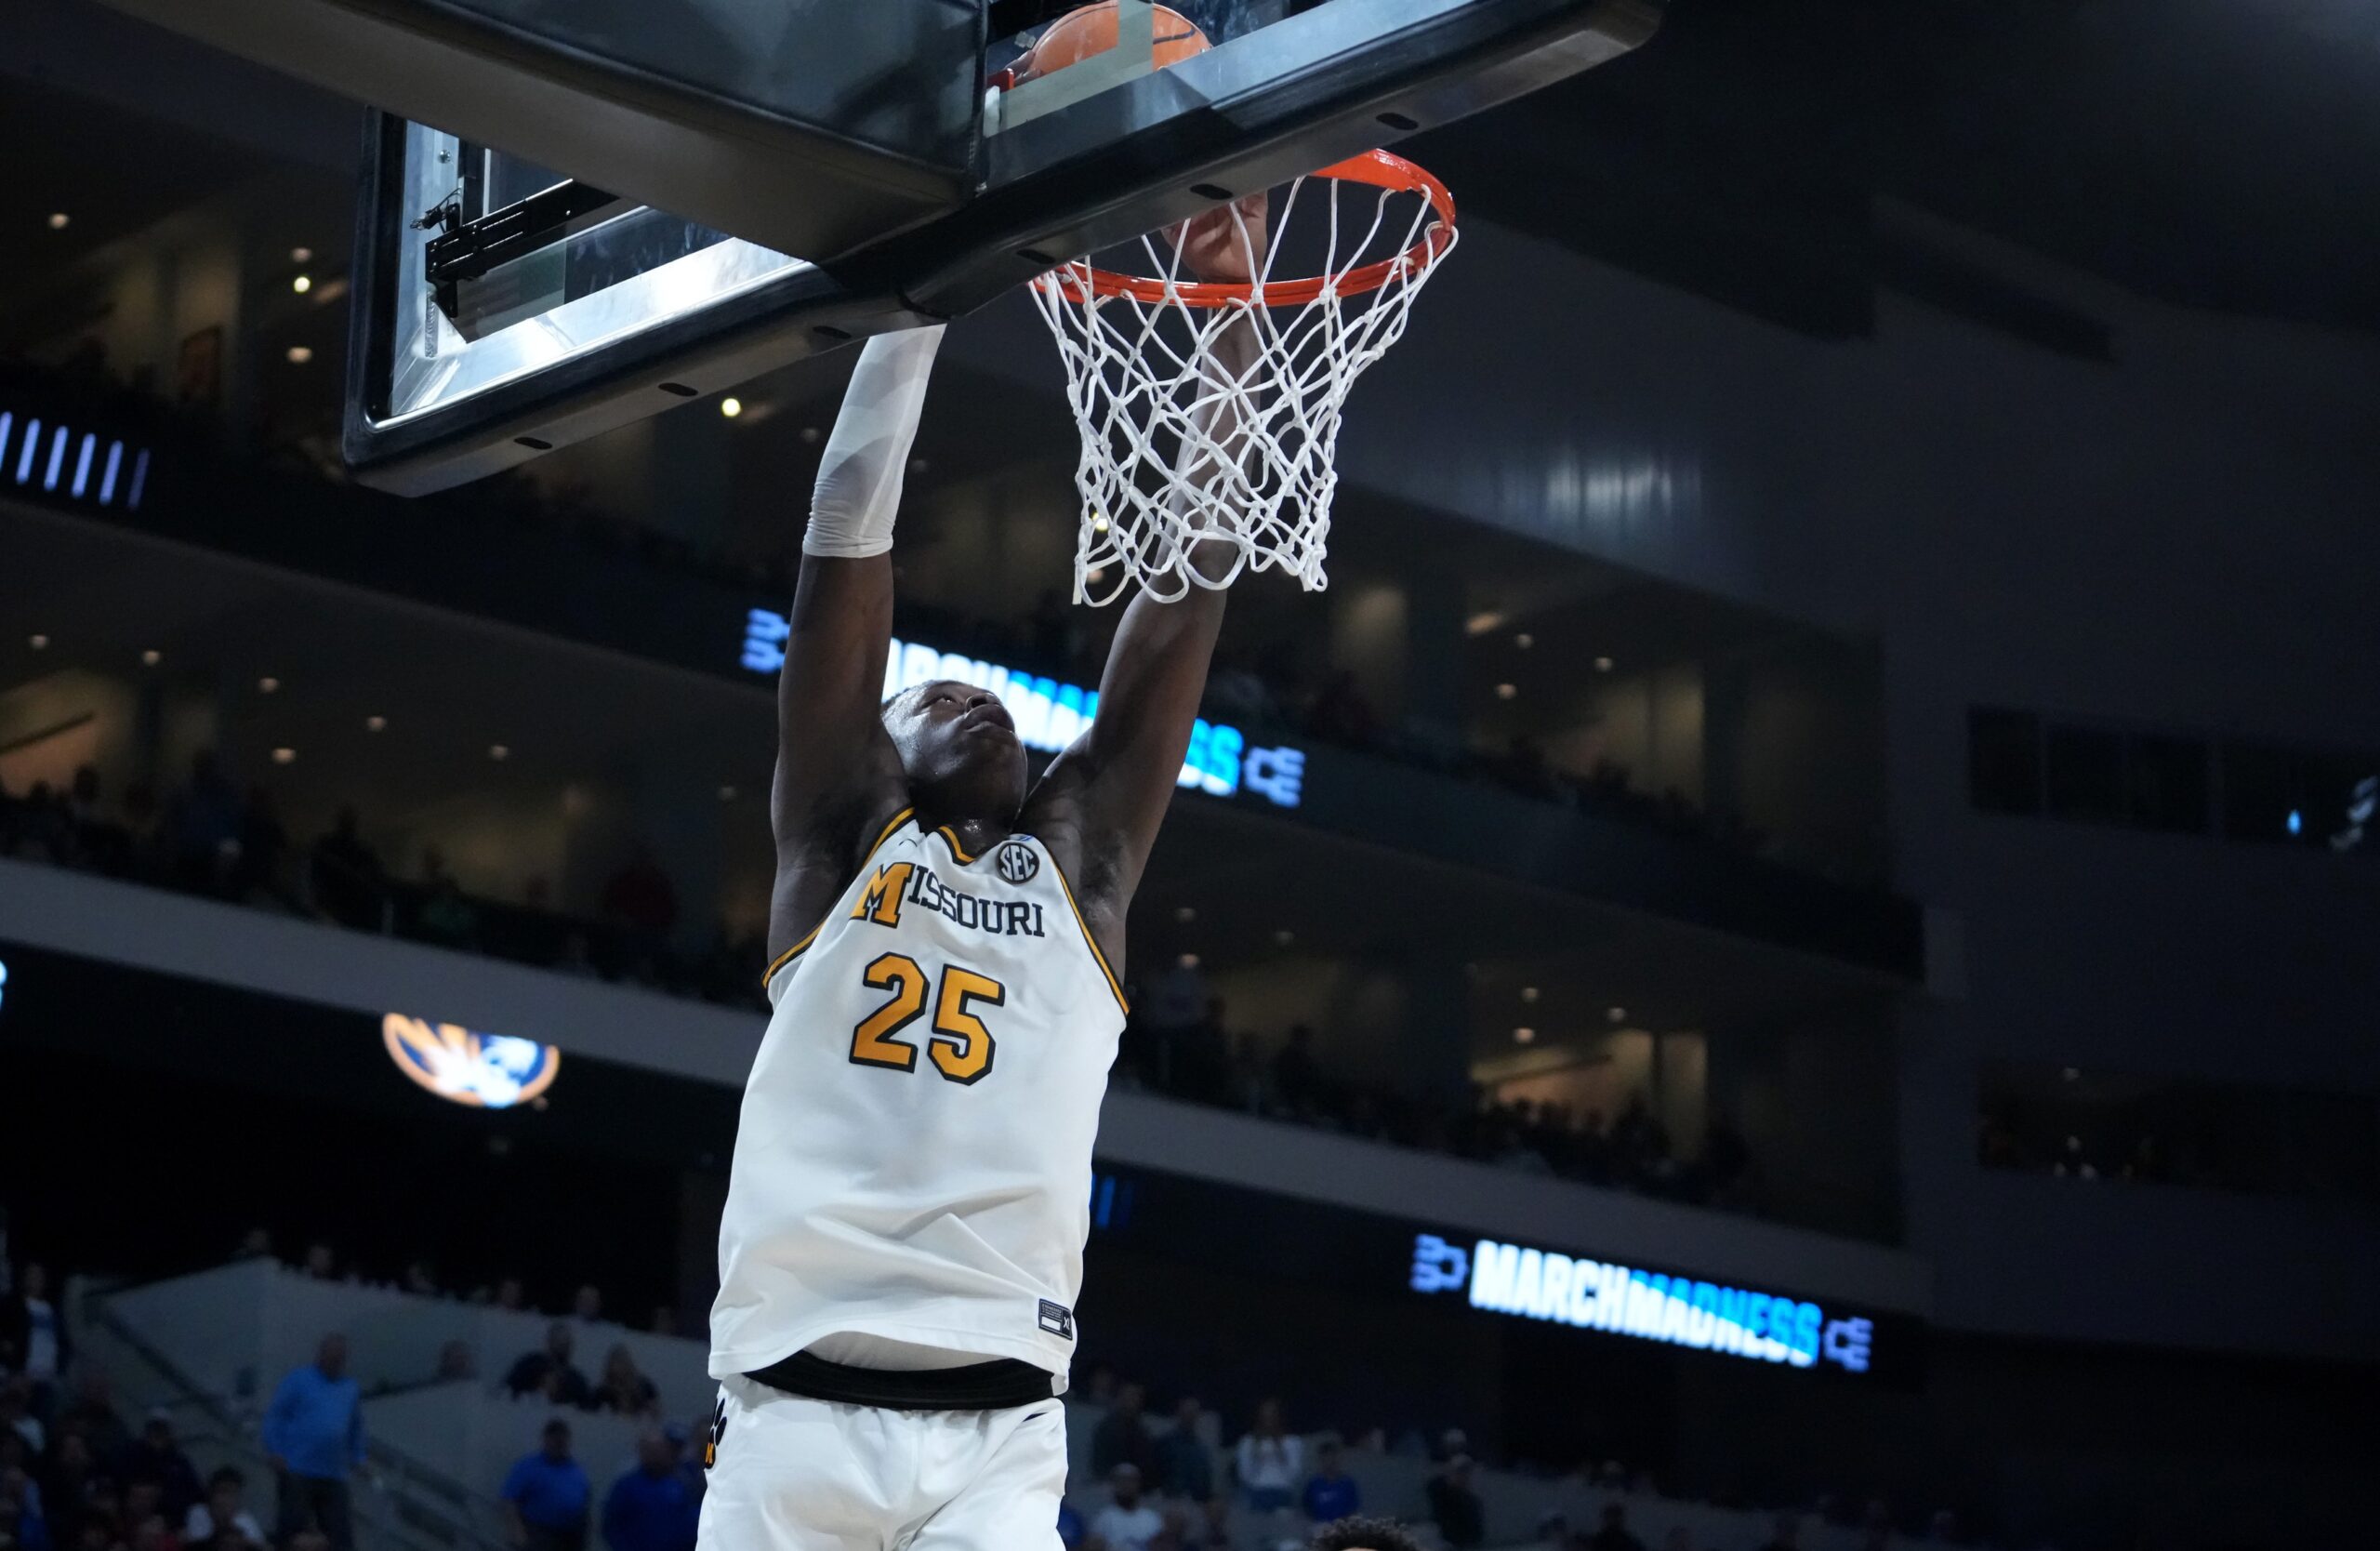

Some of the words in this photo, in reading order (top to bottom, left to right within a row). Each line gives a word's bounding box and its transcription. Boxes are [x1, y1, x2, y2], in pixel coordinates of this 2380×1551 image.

[849, 861, 1045, 937] MISSOURI
[999, 844, 1037, 882] SEC
[849, 951, 1006, 1087] 25
